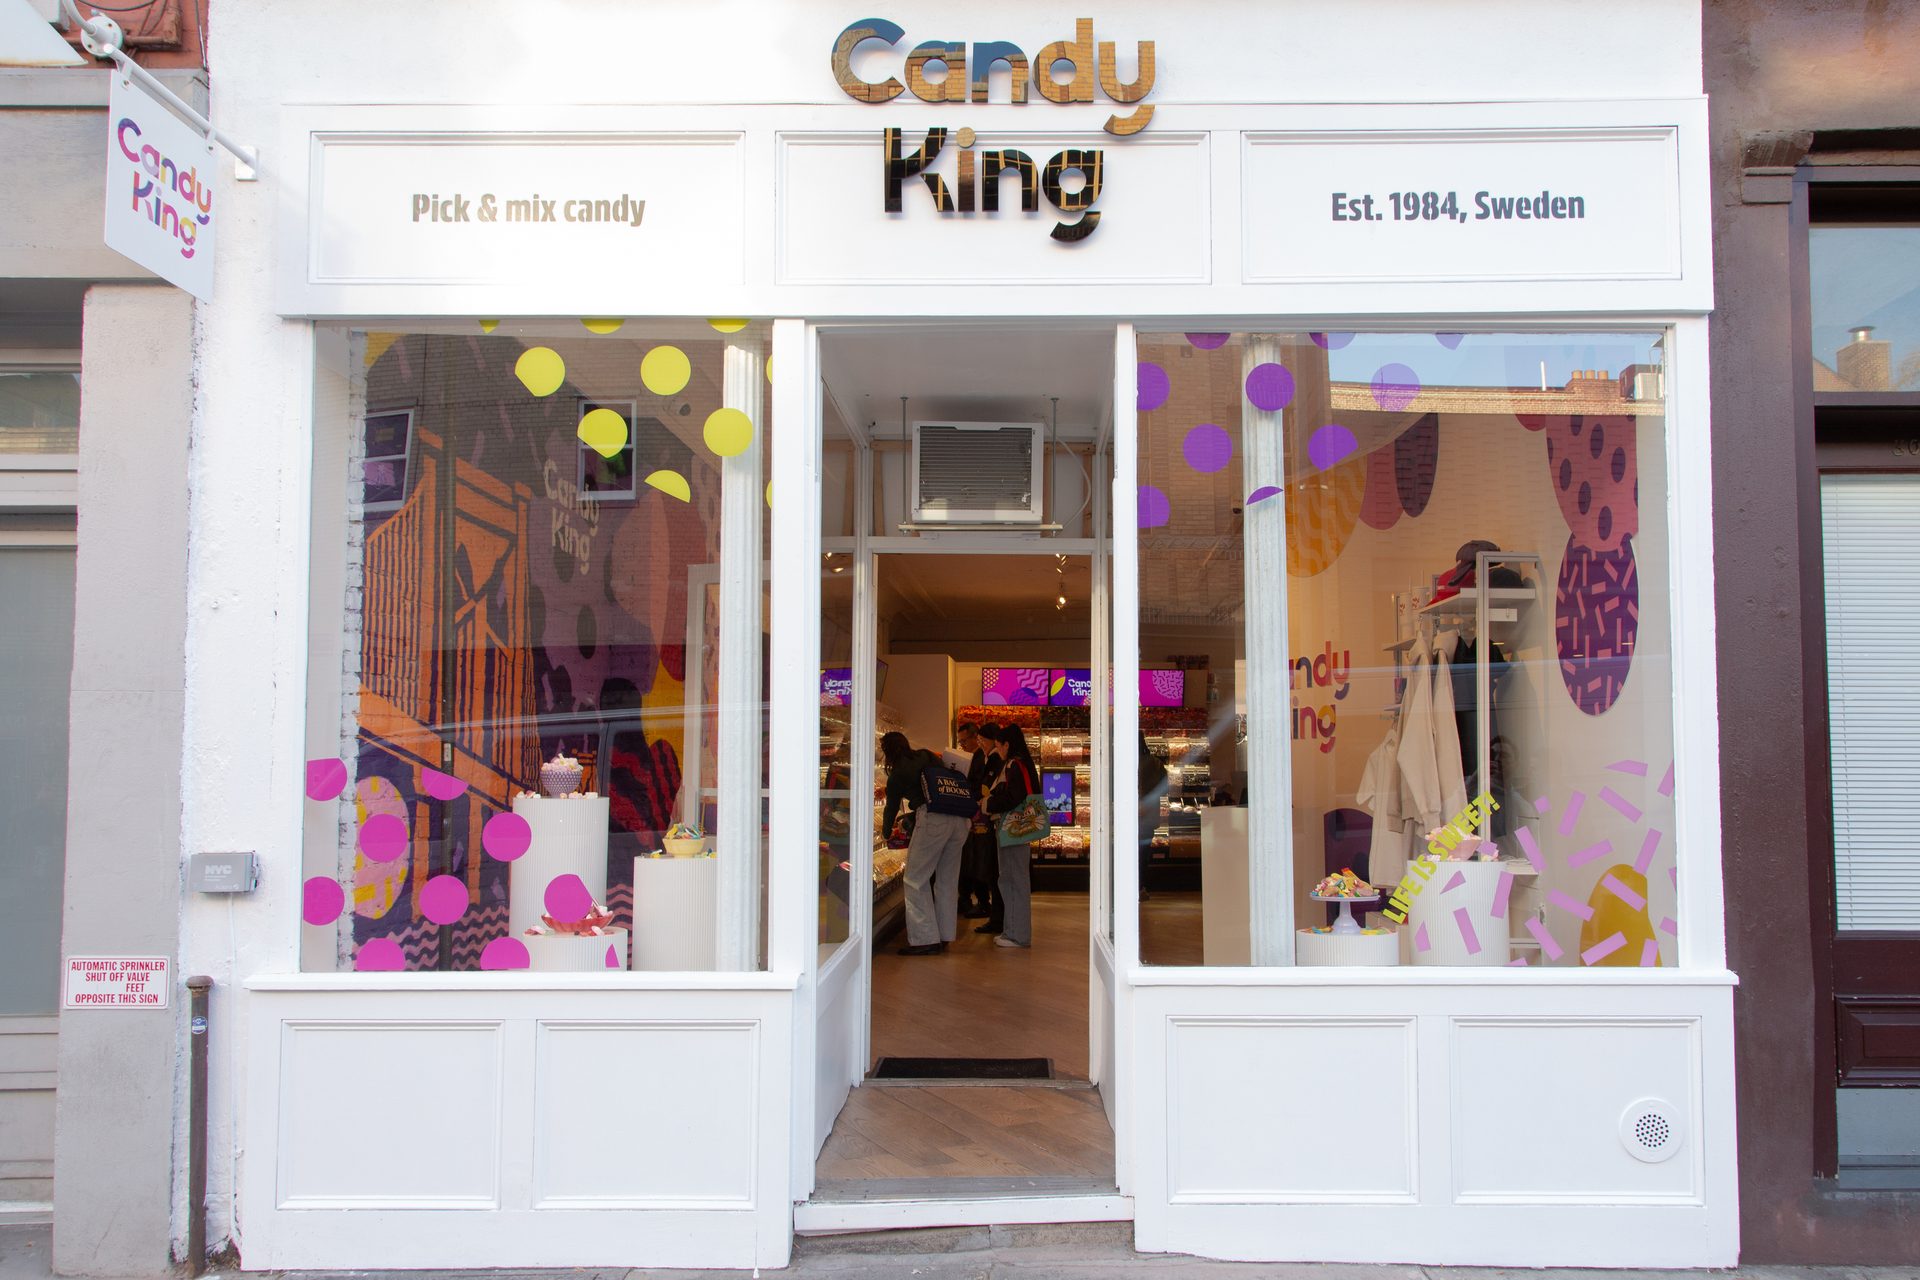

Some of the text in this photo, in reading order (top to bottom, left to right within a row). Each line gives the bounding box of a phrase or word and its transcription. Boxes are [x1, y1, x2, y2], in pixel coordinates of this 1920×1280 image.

[830, 17, 1156, 136] Candy
[117, 117, 212, 226] Candy
[883, 126, 1105, 243] King
[132, 170, 197, 259] King
[412, 193, 646, 227] Pick & mix candy
[1331, 190, 1585, 223] Est. 1984, Sweden
[551, 507, 590, 576] King
[1288, 641, 1351, 701] ndy
[1291, 695, 1337, 754] ing
[938, 785, 971, 796] of BOOKS
[943, 779, 959, 788] BAG
[204, 864, 233, 875] NYC
[1382, 790, 1501, 925] LIFE IS SWEET!
[71, 961, 165, 971] AUTOMATIC SPRINKLER
[85, 972, 150, 982] SHUT OFF VALVE
[75, 993, 159, 1003] OPPOSITE THIS SIGN
[126, 983, 145, 993] FEET
